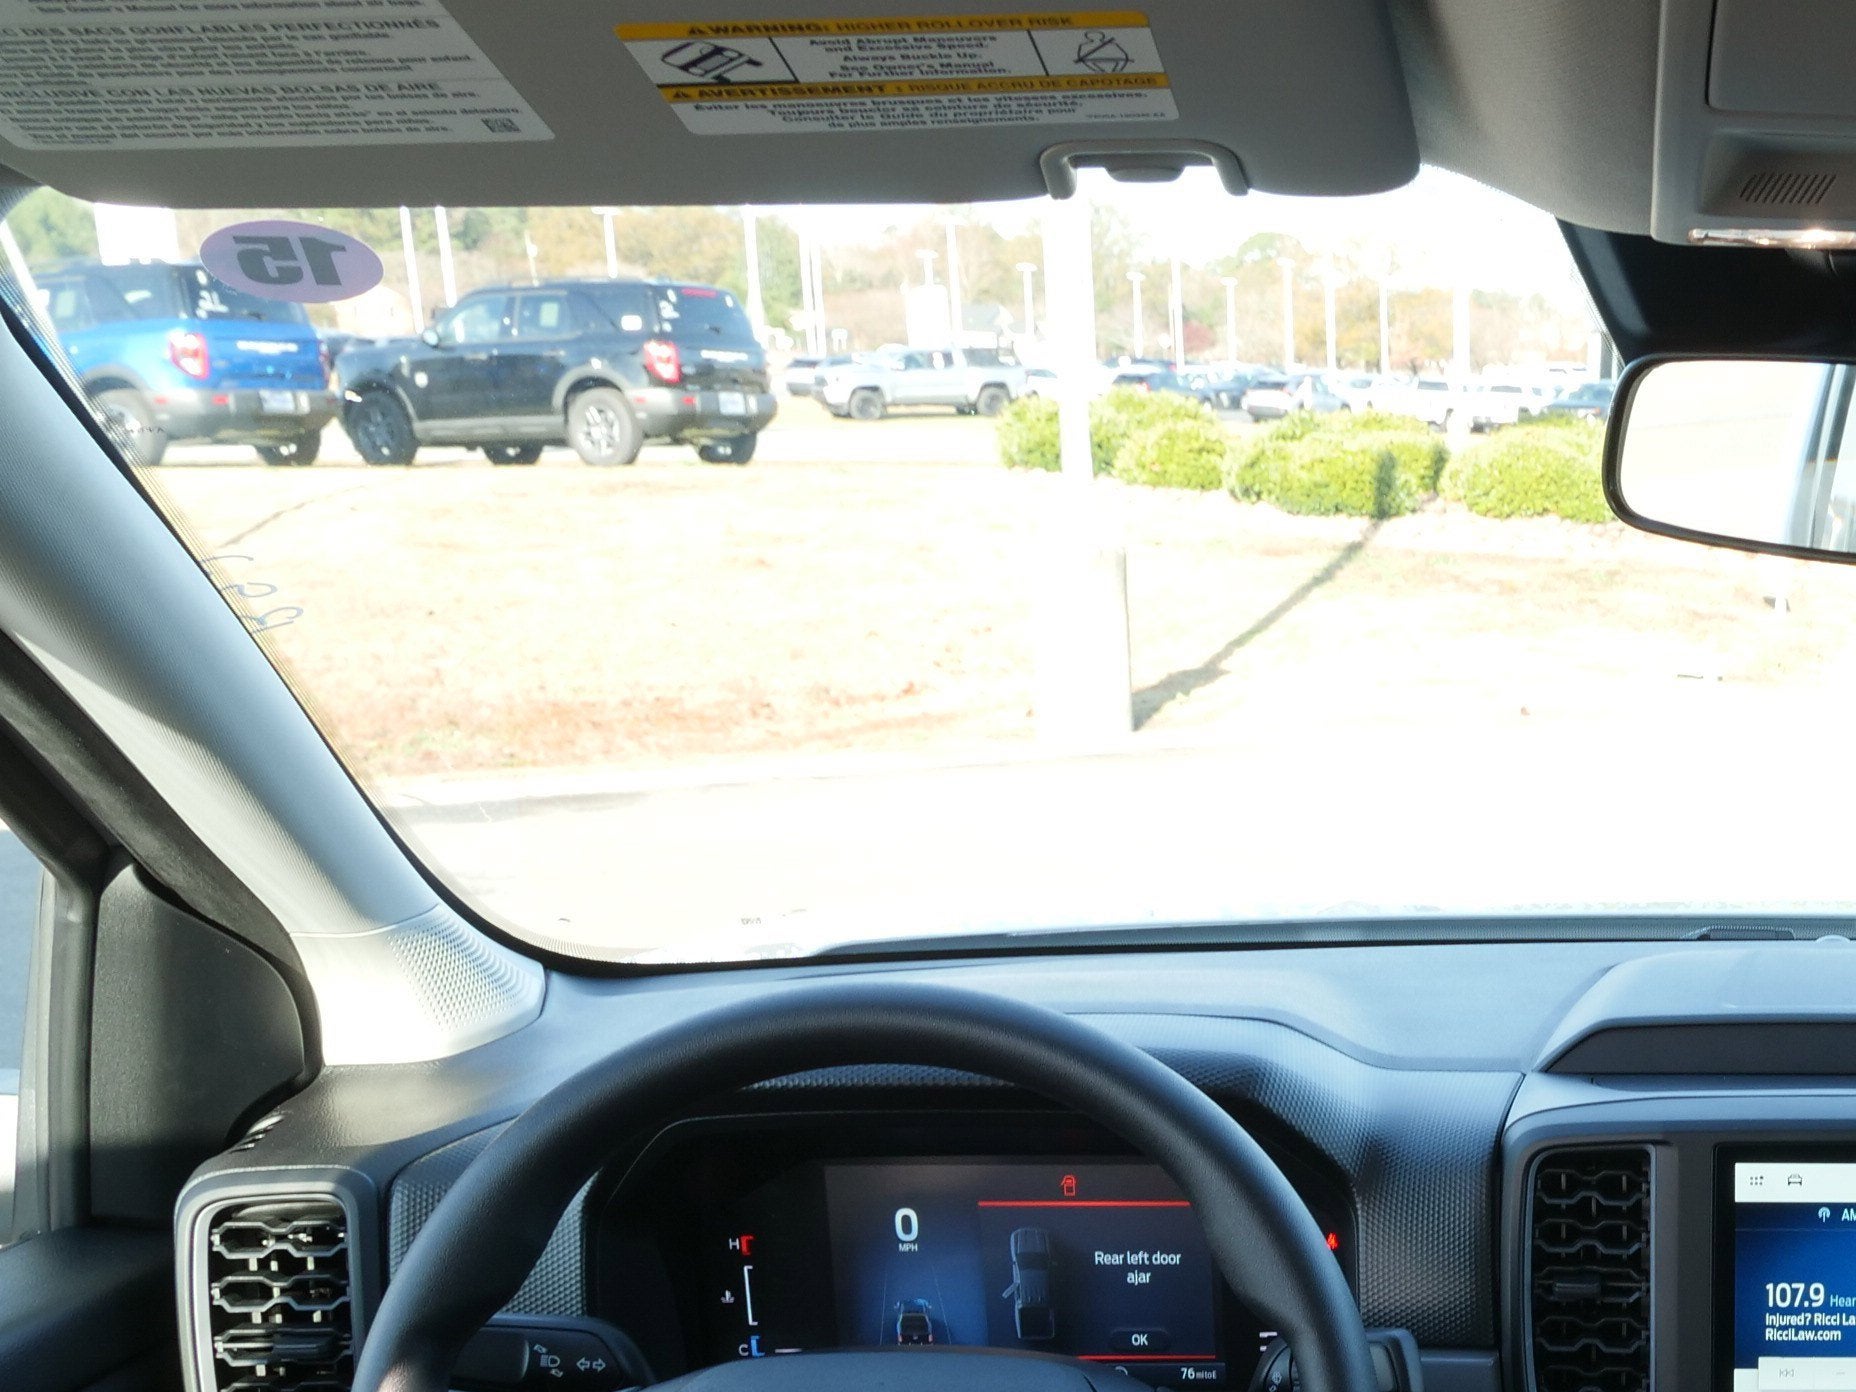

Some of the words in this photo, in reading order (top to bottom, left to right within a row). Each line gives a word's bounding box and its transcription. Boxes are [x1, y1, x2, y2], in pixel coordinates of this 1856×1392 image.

[1027, 16, 1074, 27] RISK
[894, 1207, 919, 1242] 0
[729, 1237, 740, 1250] H
[899, 1243, 918, 1252] MPH
[1095, 1251, 1124, 1265] Rear
[1127, 1251, 1149, 1265] left
[1152, 1250, 1181, 1265] door
[1127, 1269, 1151, 1286] ajar
[1765, 1282, 1825, 1308] 107.9
[1765, 1312, 1811, 1327] Injured?
[1814, 1312, 1839, 1326] Ricci
[1131, 1333, 1149, 1346] OK
[1765, 1328, 1841, 1342] RicciLaw.com
[738, 1344, 749, 1357] C
[1180, 1367, 1195, 1380] 76
